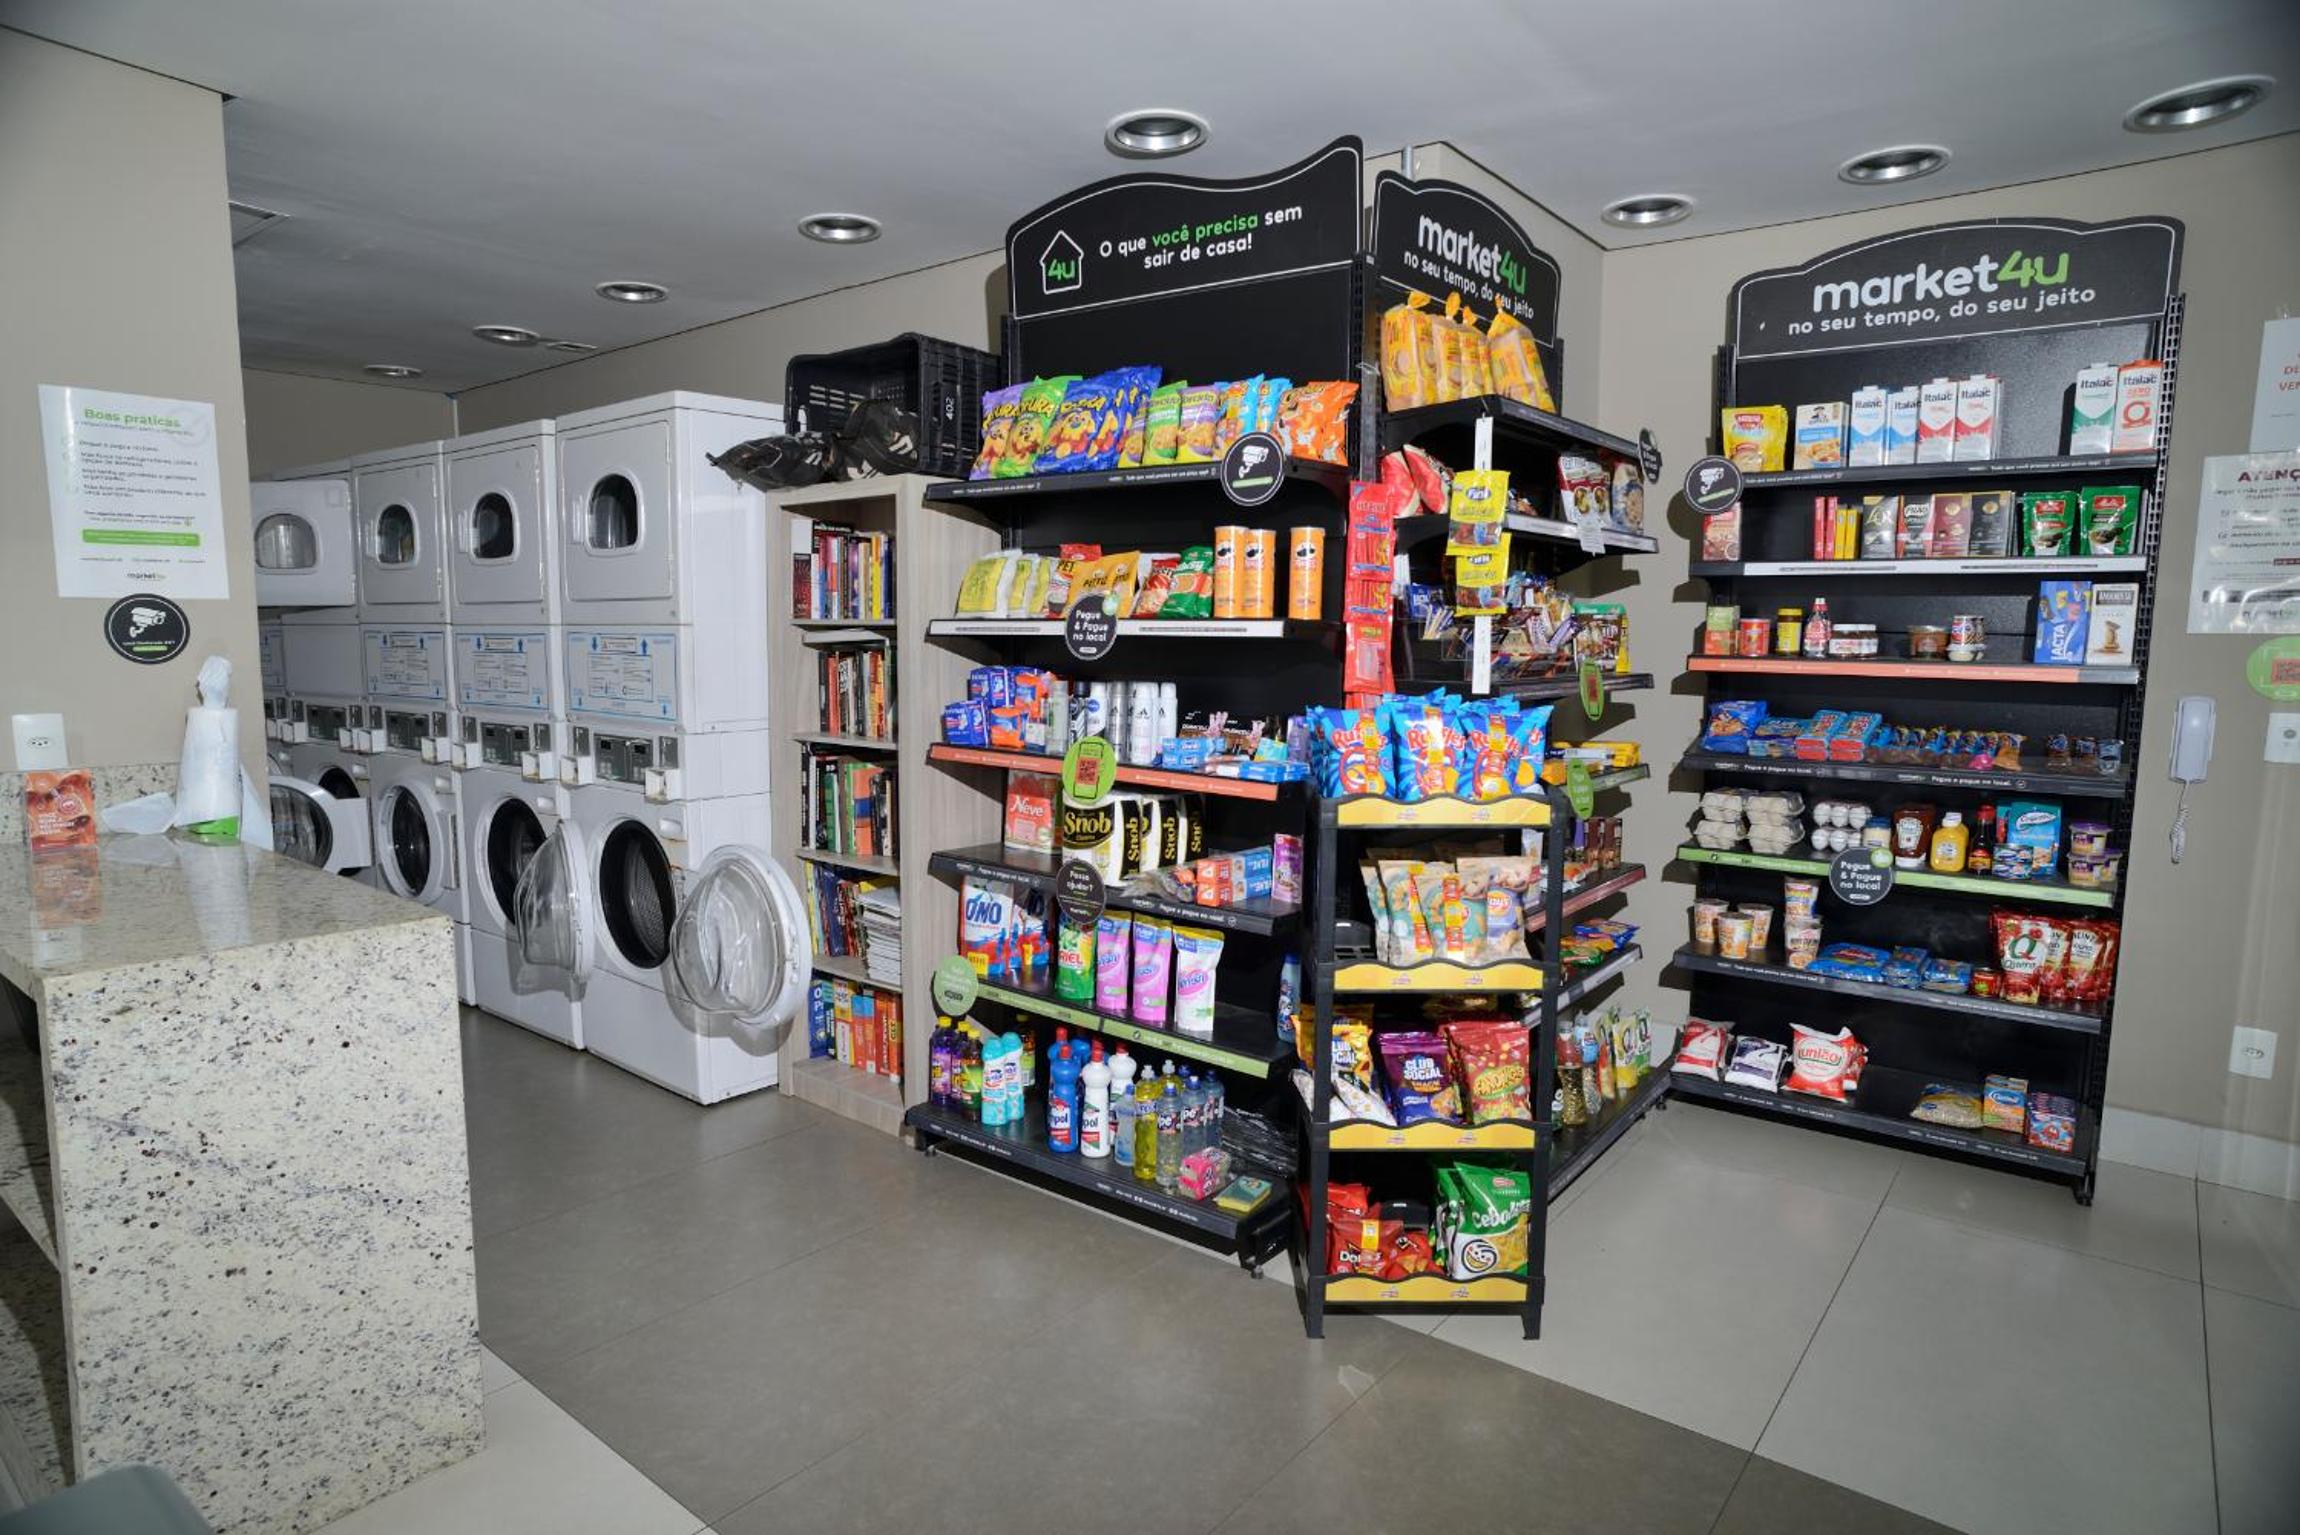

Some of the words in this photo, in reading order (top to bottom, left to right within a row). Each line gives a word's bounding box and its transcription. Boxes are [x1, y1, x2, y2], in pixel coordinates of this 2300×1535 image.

[1100, 241, 1112, 257] O
[1118, 236, 1146, 259] que
[1152, 225, 1189, 247] você
[1195, 214, 1259, 243] precisa
[1264, 206, 1302, 226] sem
[1144, 250, 1173, 269] sair
[1180, 245, 1201, 262] de
[1206, 233, 1253, 258] casa!
[1404, 251, 1418, 269] no
[1421, 261, 1441, 280] seu
[1444, 265, 1479, 299] tempo,
[1481, 285, 1493, 301] do
[1513, 297, 1535, 320] jeito
[1788, 318, 1813, 336] no
[1820, 314, 1856, 333] seu
[1864, 306, 1941, 329] tempo,
[1950, 300, 1977, 317] do
[1986, 294, 2027, 314] seu
[2036, 285, 2096, 313] jeito
[84, 407, 121, 421] Boas
[1076, 610, 1101, 621] Pegue
[1082, 622, 1108, 632] Pague
[1086, 632, 1106, 641] local
[1009, 795, 1045, 818] Neve
[1064, 811, 1112, 836] Snob
[1126, 817, 1141, 862] Snob
[1163, 817, 1177, 860] Snob
[1840, 861, 1871, 872] Pegue
[1850, 872, 1882, 882] Pague
[1856, 881, 1881, 890] local
[965, 898, 1002, 925] OMO
[1059, 952, 1083, 964] RIEL
[1404, 1067, 1444, 1081] SOCIAL
